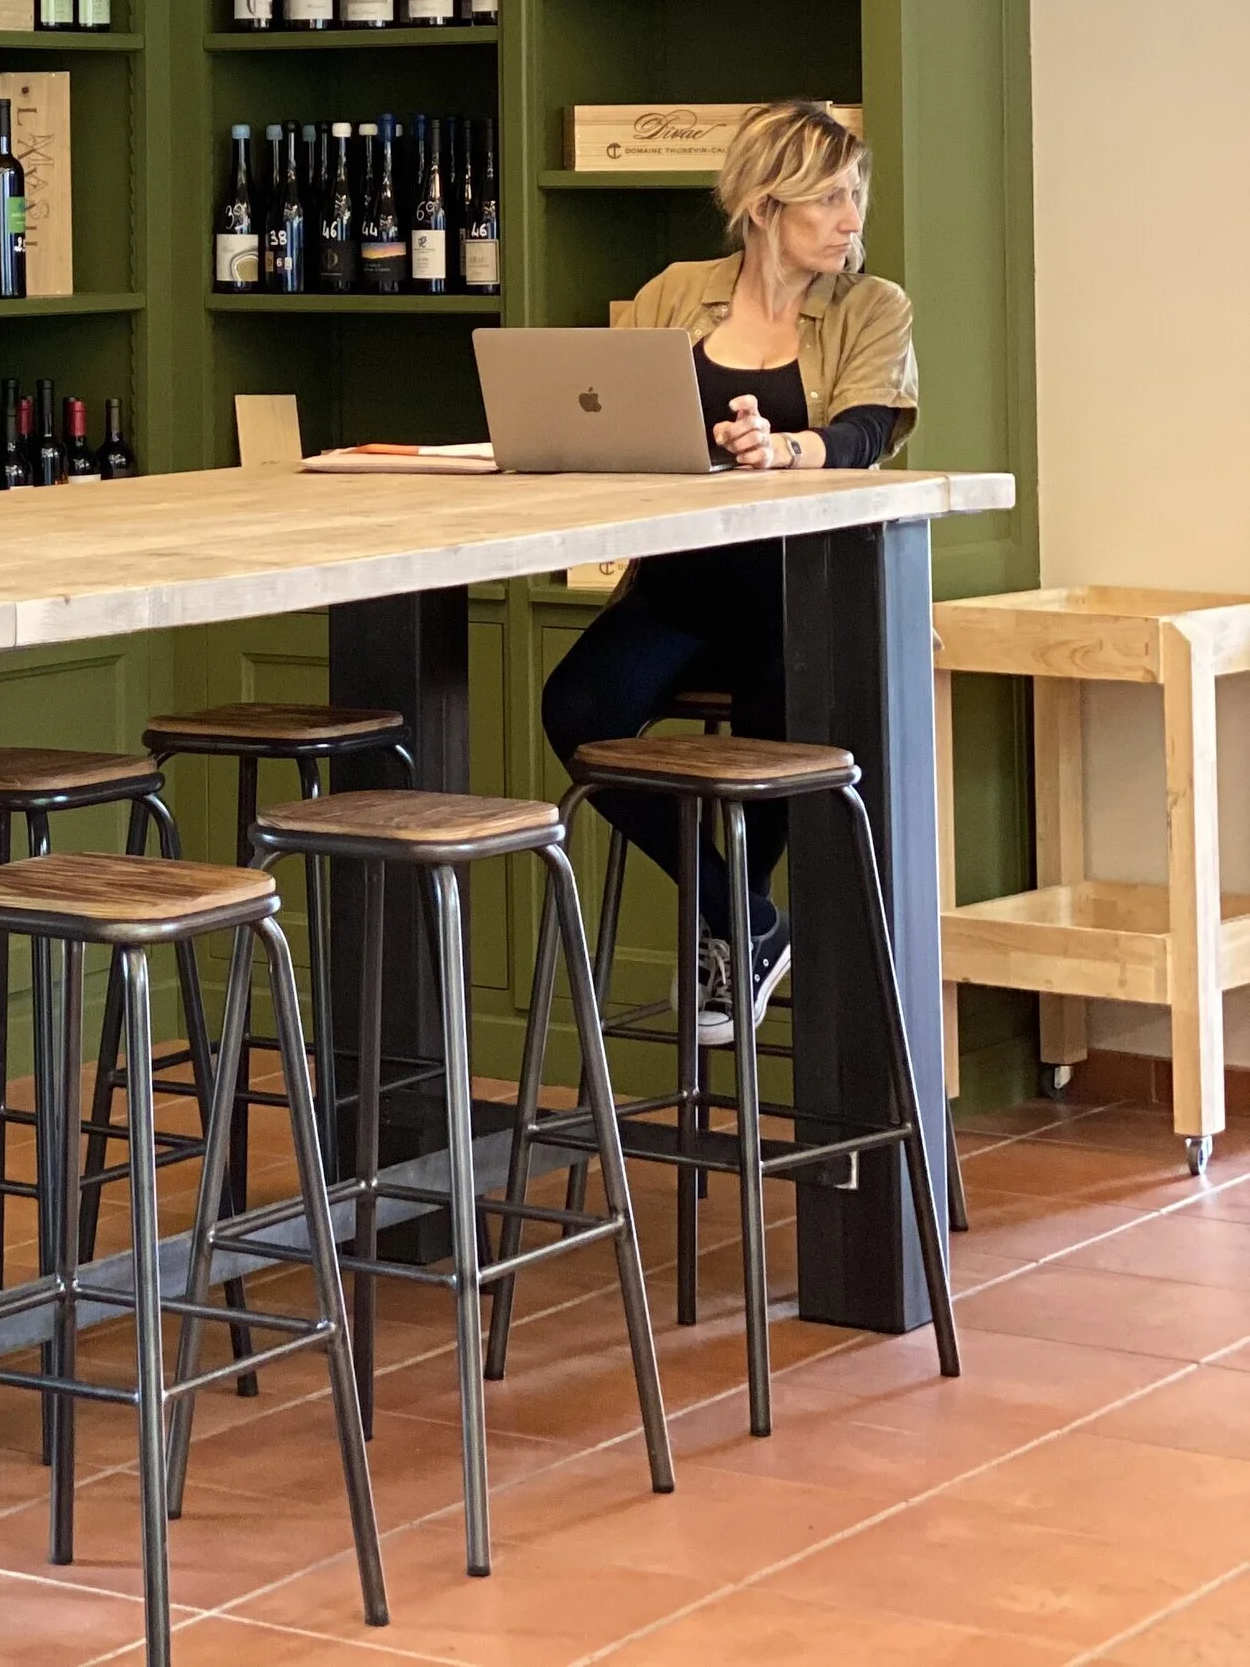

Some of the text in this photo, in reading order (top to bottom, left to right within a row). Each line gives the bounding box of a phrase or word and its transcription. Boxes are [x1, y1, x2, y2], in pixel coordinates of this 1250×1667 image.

[624, 147, 662, 155] DOMAINE
[322, 219, 338, 239] 46
[361, 220, 378, 237] 44
[471, 221, 488, 238] 46
[269, 230, 287, 246] 38
